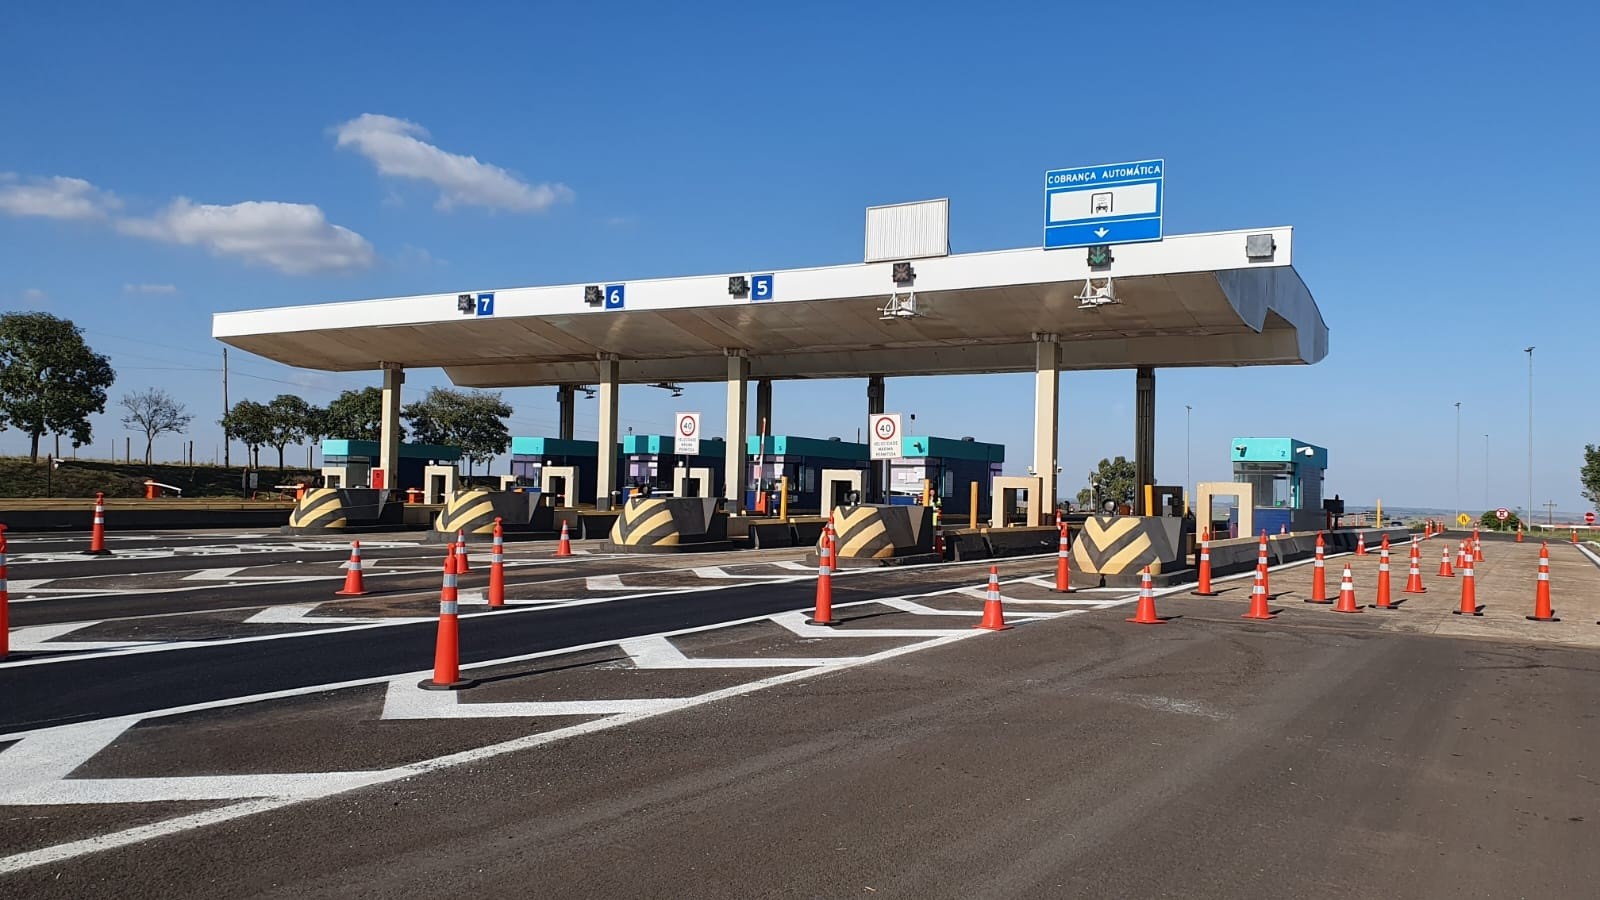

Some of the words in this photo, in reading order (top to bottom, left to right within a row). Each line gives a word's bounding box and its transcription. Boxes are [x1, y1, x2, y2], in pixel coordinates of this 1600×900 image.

[1048, 171, 1097, 184] COBRANÇA
[1101, 164, 1161, 179] AUTOMÁTICA
[757, 280, 768, 296] 5
[610, 289, 620, 304] 6
[481, 298, 490, 312] 7
[683, 422, 693, 430] 40
[879, 424, 891, 432] 40
